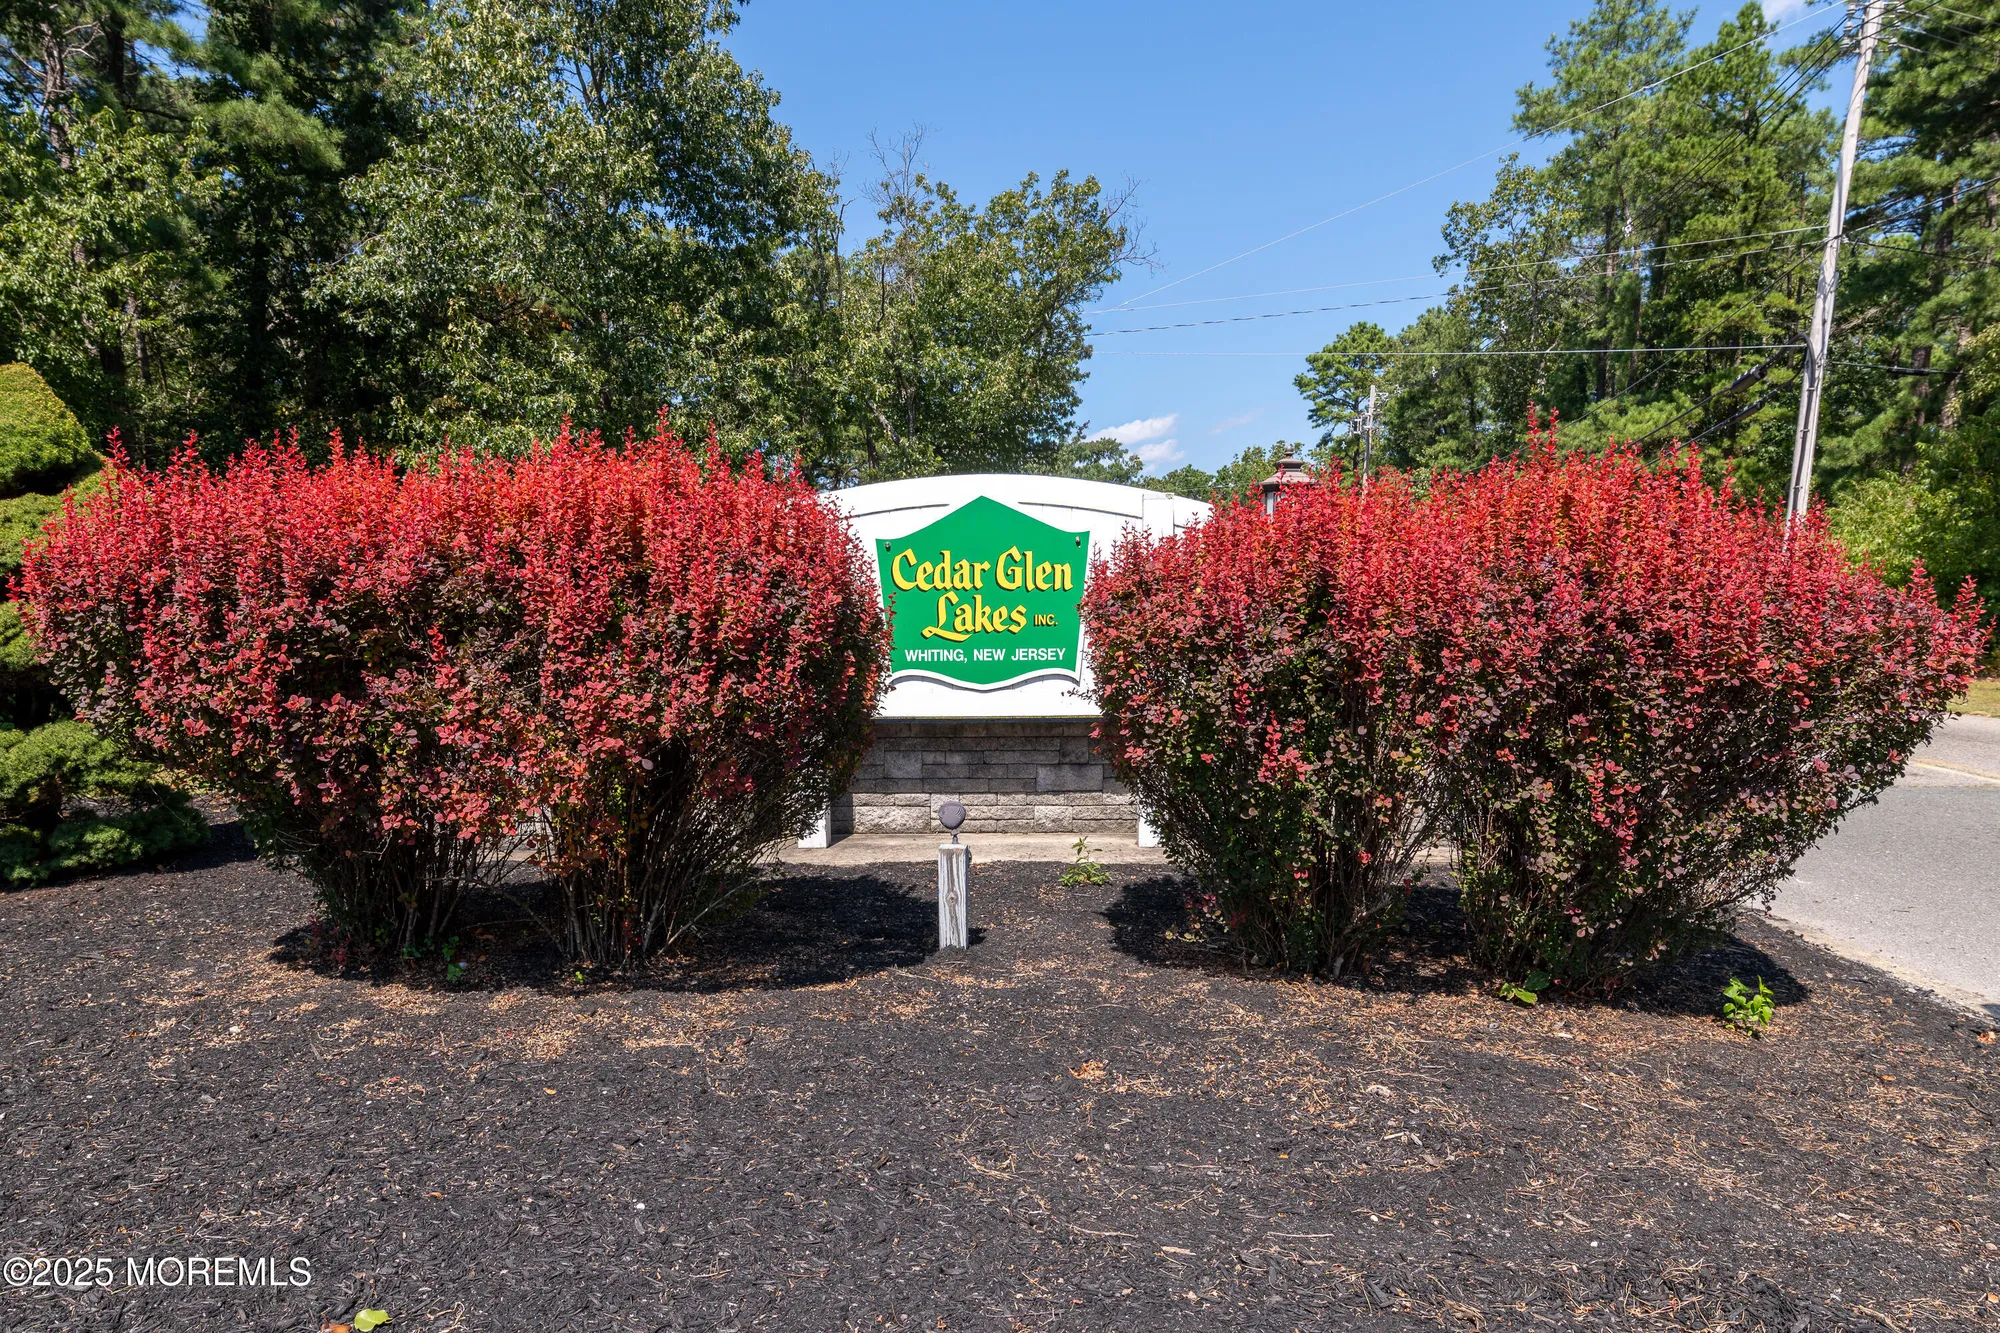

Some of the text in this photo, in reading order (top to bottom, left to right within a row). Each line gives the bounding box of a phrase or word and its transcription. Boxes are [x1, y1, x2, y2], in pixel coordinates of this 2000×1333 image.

[891, 545, 1074, 592] Cedar Glen
[921, 591, 1059, 642] Lakes INC.
[904, 647, 1066, 664] WHITING, NEW JERSEY
